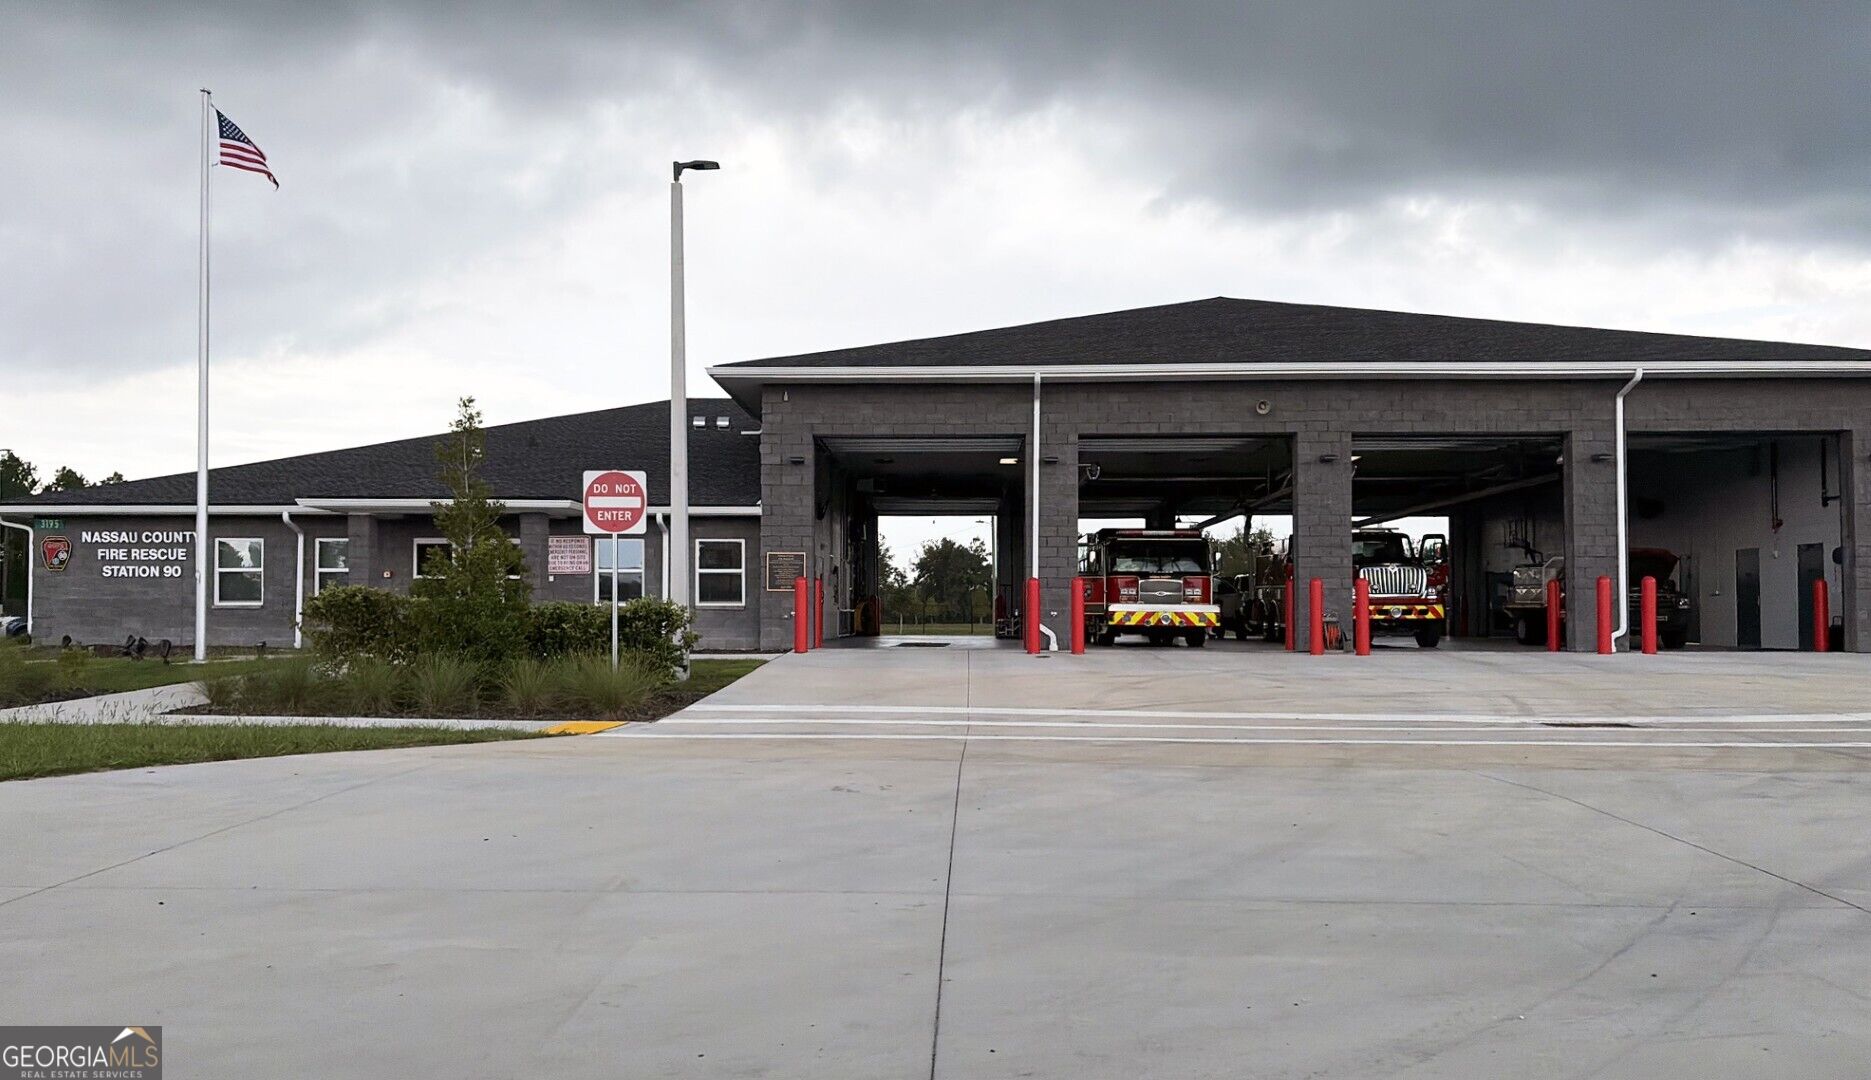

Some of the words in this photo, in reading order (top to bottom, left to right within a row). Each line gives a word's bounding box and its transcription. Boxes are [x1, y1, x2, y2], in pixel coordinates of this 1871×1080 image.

[593, 484, 608, 494] DO
[615, 484, 637, 494] NOT
[597, 511, 632, 521] ENTER
[40, 519, 59, 529] 3195
[81, 531, 138, 543] NASSAU
[97, 548, 128, 560] FIRE
[131, 548, 187, 560] RESCUE
[102, 565, 160, 577] STATION
[163, 565, 182, 577] 90
